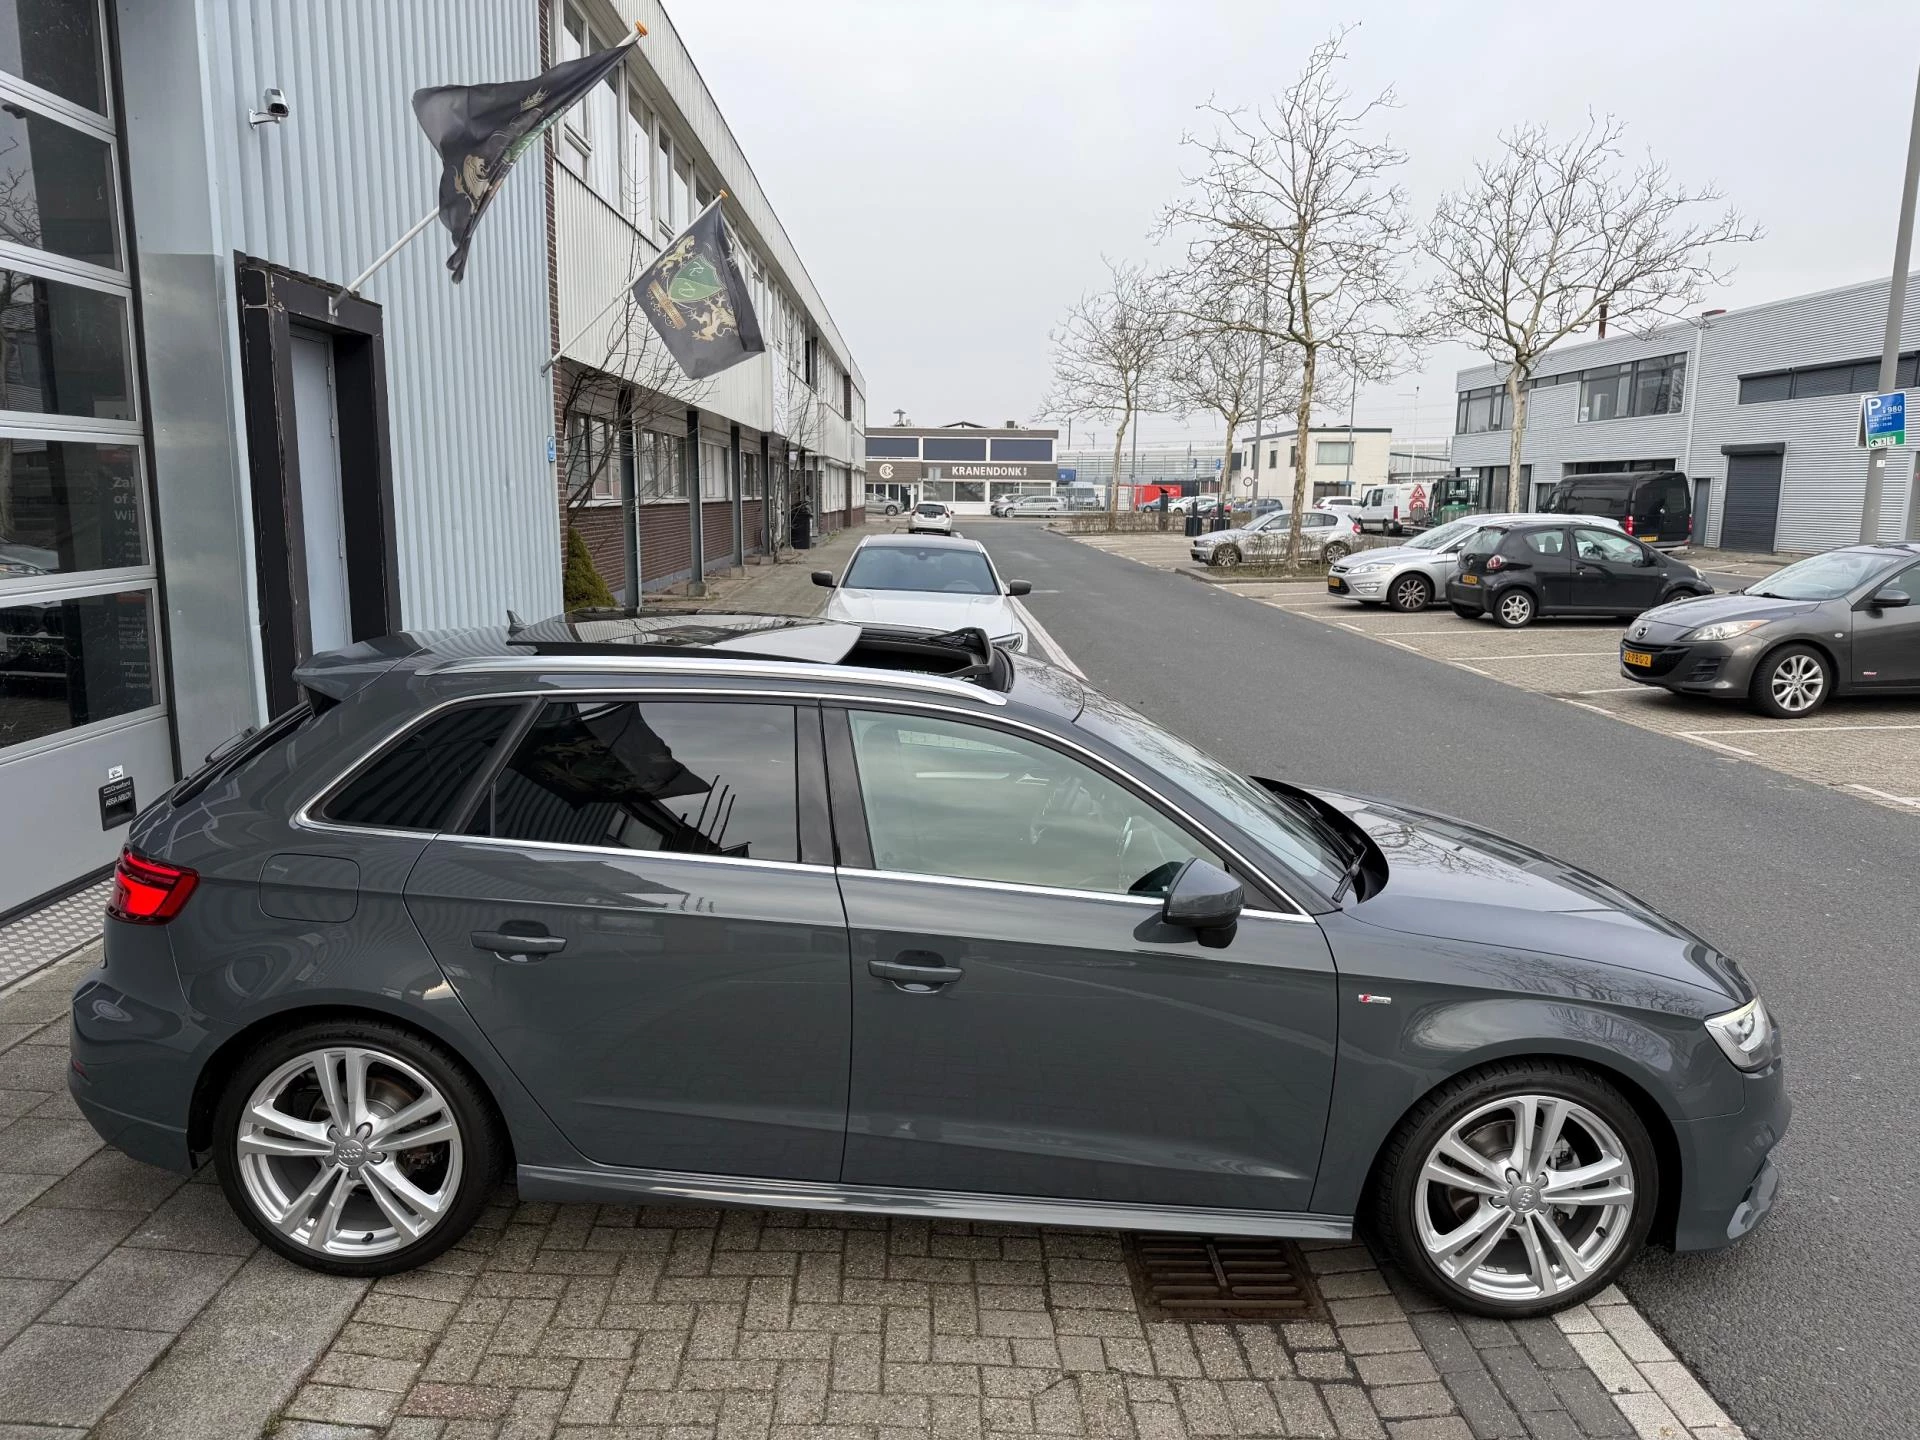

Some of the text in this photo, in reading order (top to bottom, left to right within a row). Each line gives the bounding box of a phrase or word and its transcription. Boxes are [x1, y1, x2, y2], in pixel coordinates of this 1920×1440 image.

[1867, 399, 1903, 415] P 980
[952, 466, 1022, 476] KRANENDONK
[114, 493, 128, 504] of
[115, 510, 136, 523] Wij
